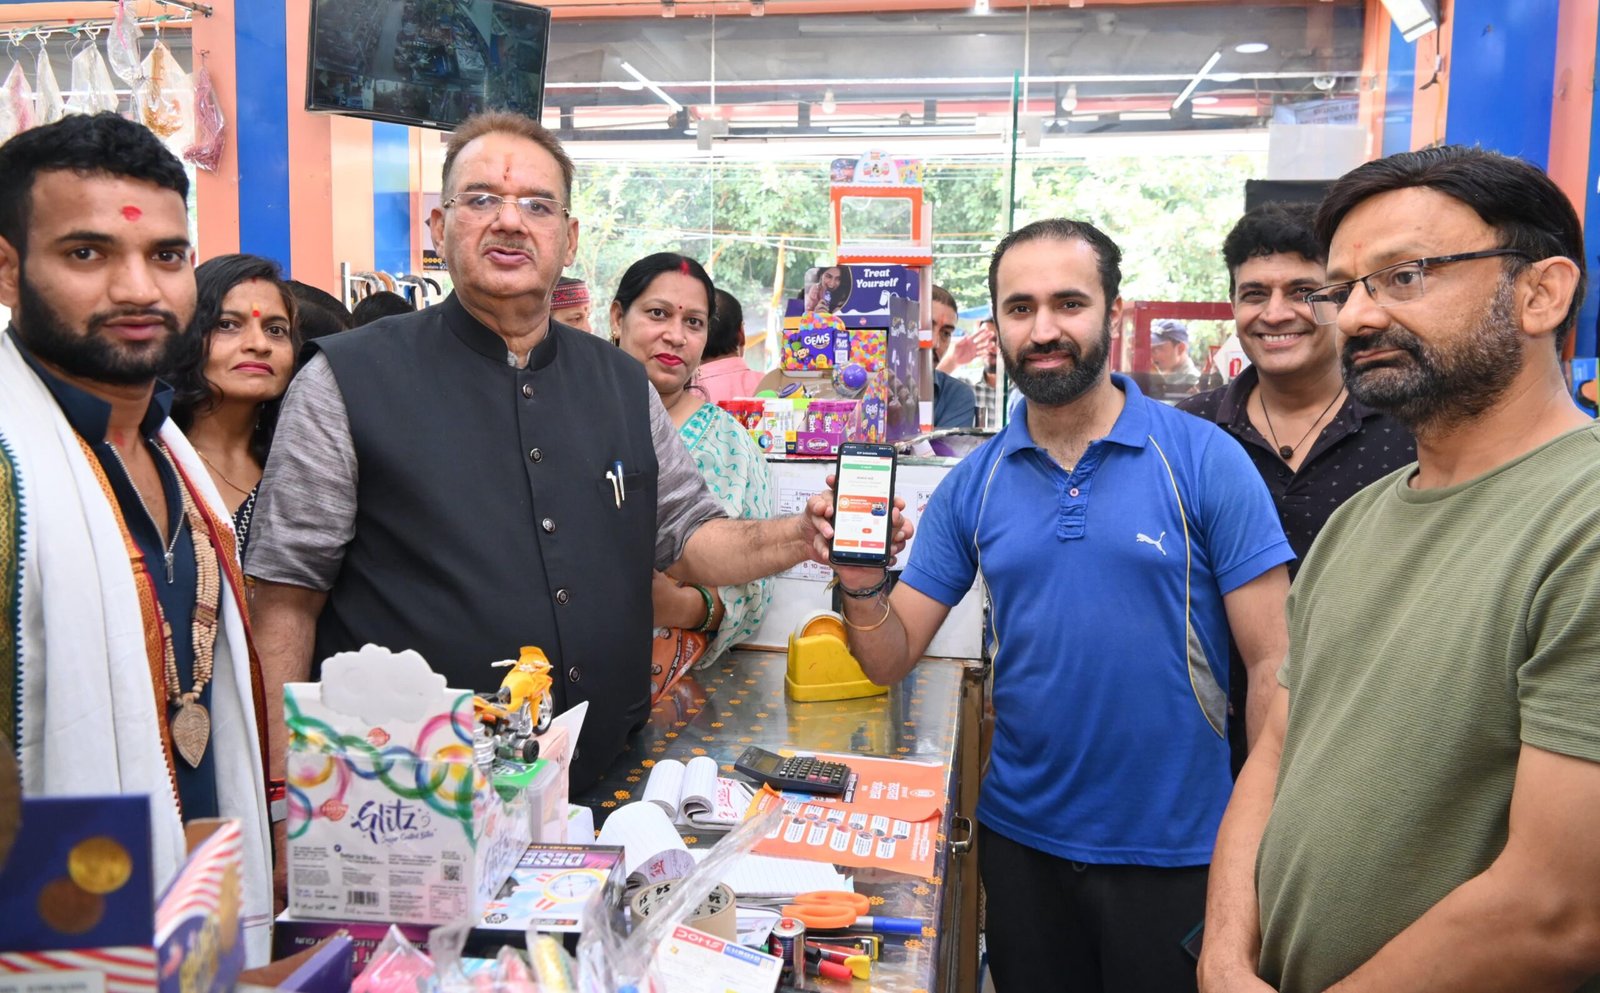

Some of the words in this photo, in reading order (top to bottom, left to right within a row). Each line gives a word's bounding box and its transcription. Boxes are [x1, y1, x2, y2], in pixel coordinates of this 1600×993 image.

[863, 268, 891, 278] Treat
[855, 277, 900, 289] Yourself
[804, 332, 831, 346] GEMS
[350, 798, 418, 844] Glitz
[519, 852, 586, 867] DESE
